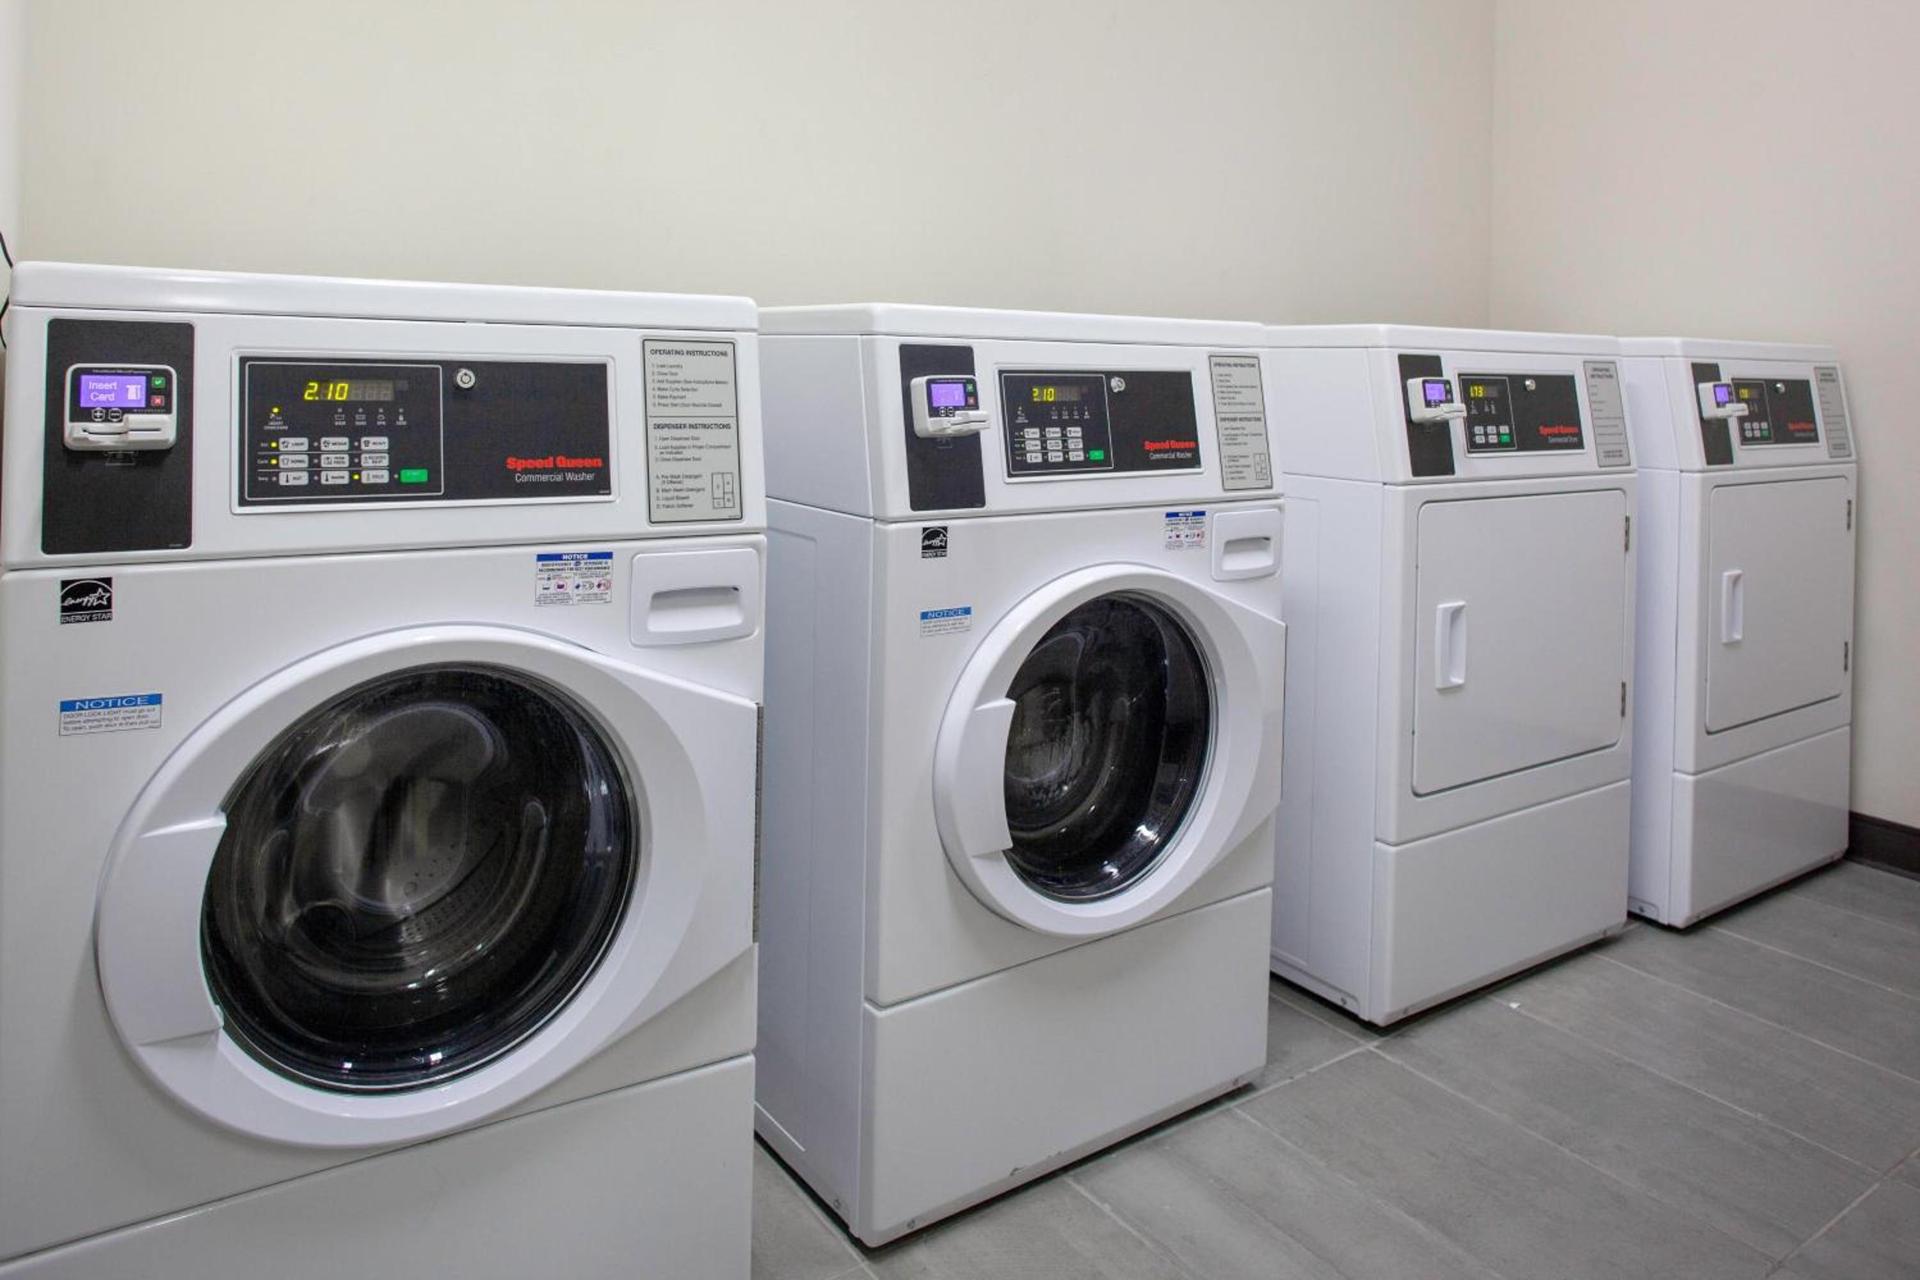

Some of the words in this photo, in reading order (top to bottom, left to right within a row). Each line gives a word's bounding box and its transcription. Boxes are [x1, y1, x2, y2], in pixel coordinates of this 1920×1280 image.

[89, 381, 117, 390] Insert
[304, 382, 349, 400] 2.10
[90, 393, 115, 402] Card
[1144, 440, 1169, 451] Speed
[1170, 440, 1196, 448] Queen
[506, 456, 553, 471] Speed
[556, 456, 603, 468] Queen
[515, 472, 563, 483] Commercial
[566, 472, 595, 481] Washer
[62, 614, 90, 623] ENERGY
[927, 609, 966, 619] NOTICE
[76, 696, 149, 710] NOTICE
